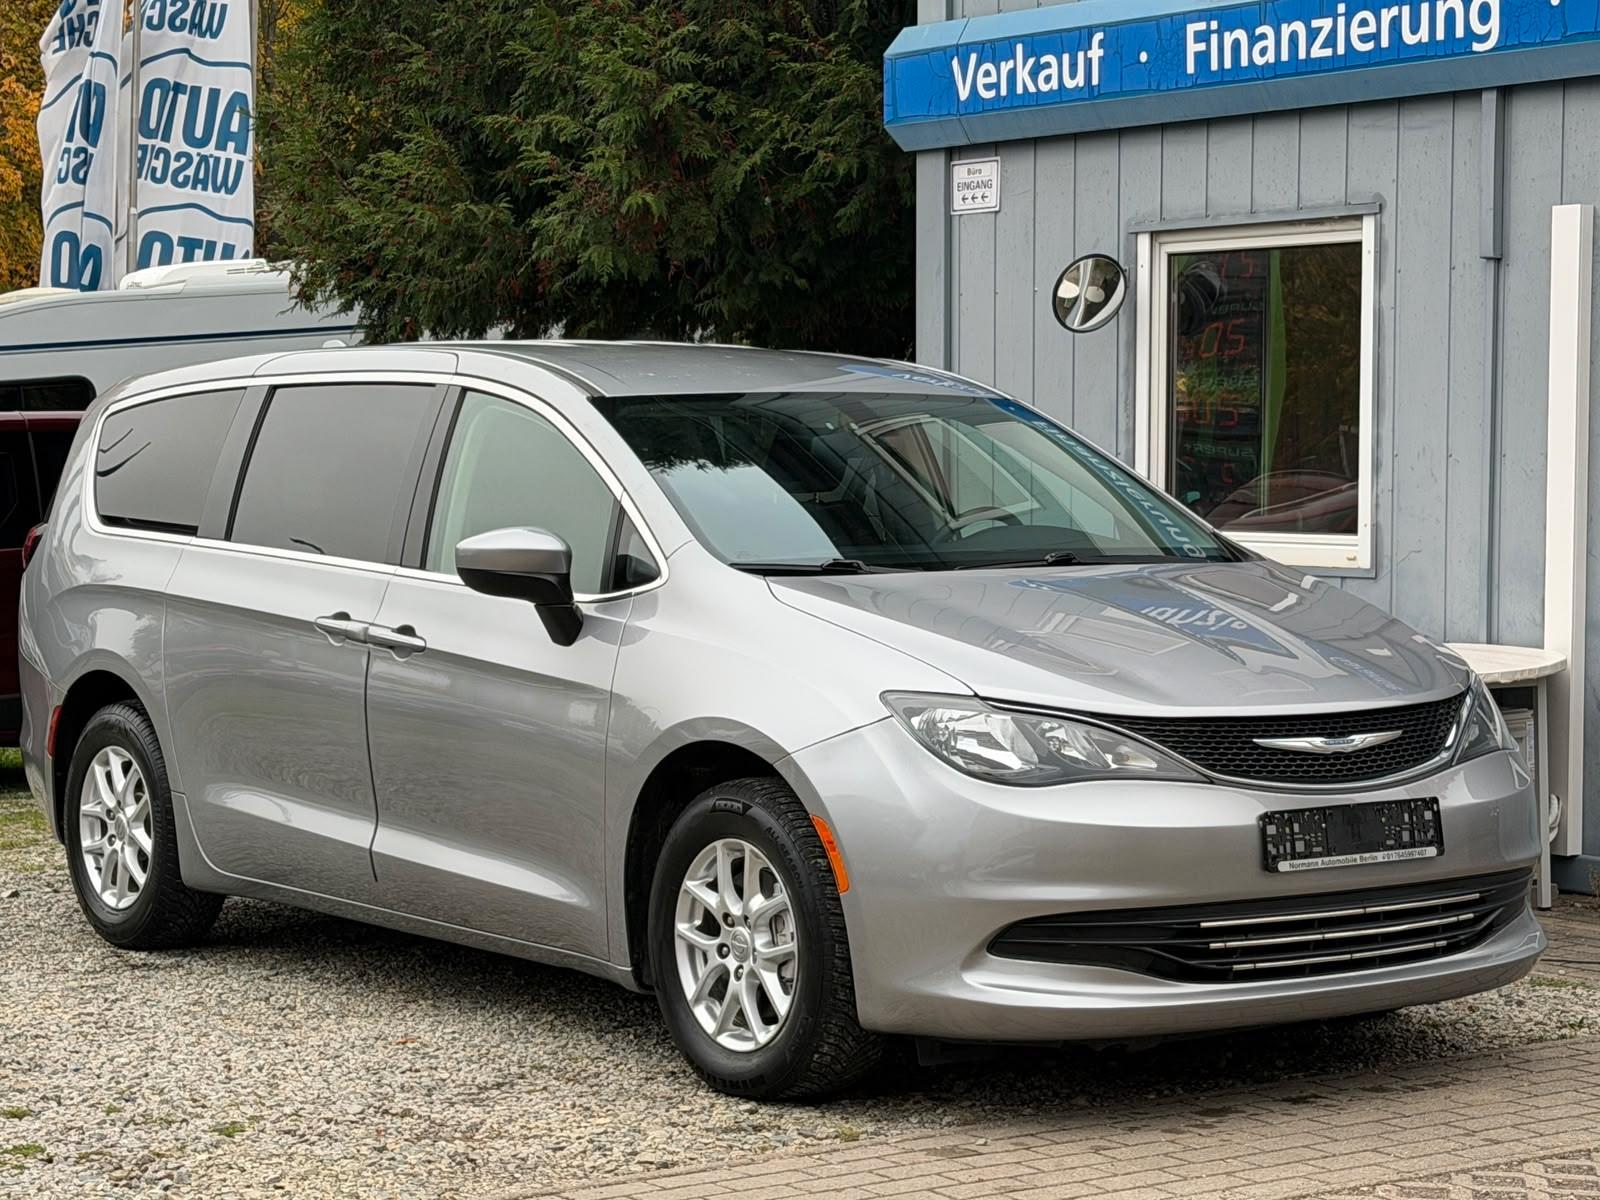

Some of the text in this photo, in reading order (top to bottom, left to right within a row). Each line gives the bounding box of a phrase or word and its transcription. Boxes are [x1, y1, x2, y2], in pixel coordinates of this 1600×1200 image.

[952, 0, 1500, 101] Verkauf Finanzierung
[967, 167, 983, 176] Büro
[957, 179, 993, 192] EINGANG
[1320, 856, 1358, 867] Automobile
[1359, 853, 1378, 864] Berlin
